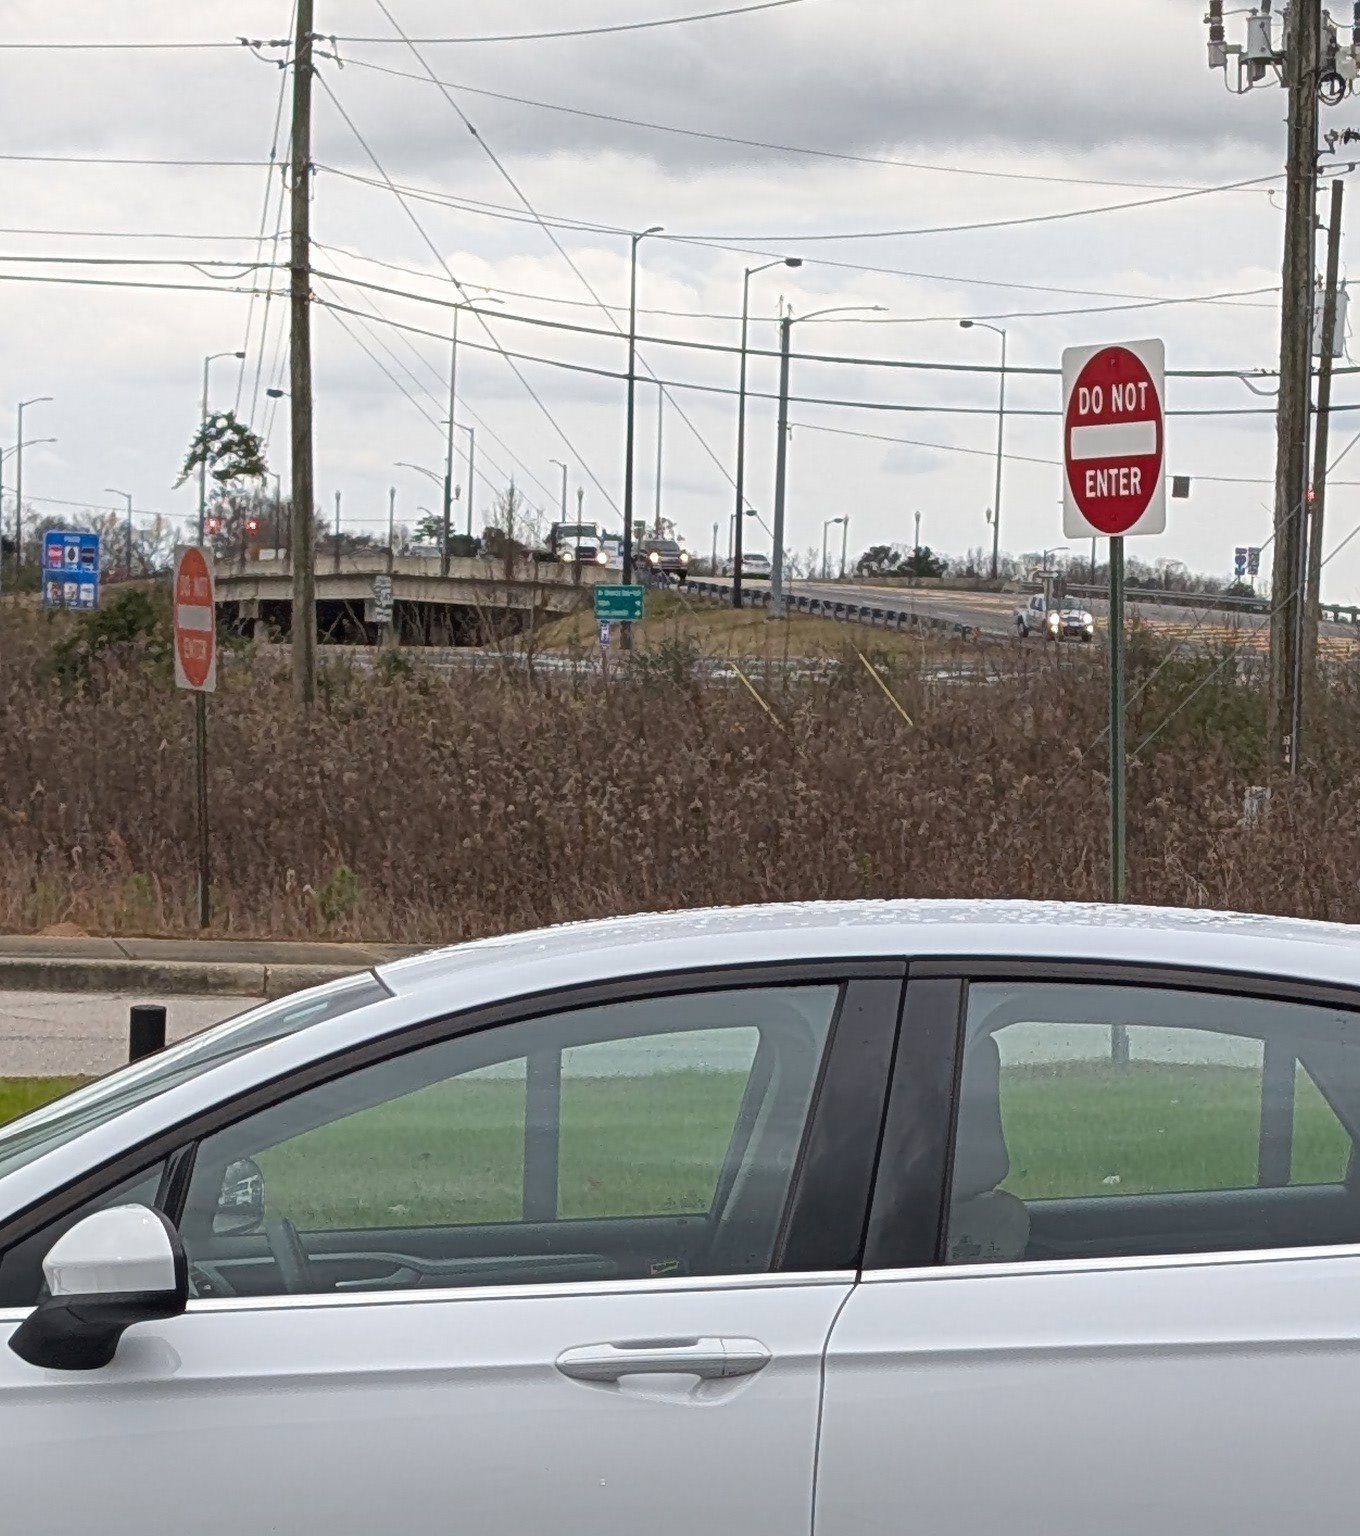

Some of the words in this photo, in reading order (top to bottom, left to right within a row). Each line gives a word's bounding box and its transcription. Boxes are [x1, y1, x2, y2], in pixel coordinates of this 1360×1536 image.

[1079, 385, 1103, 415] DO
[1111, 381, 1148, 413] NOT
[1085, 466, 1142, 498] ENTER
